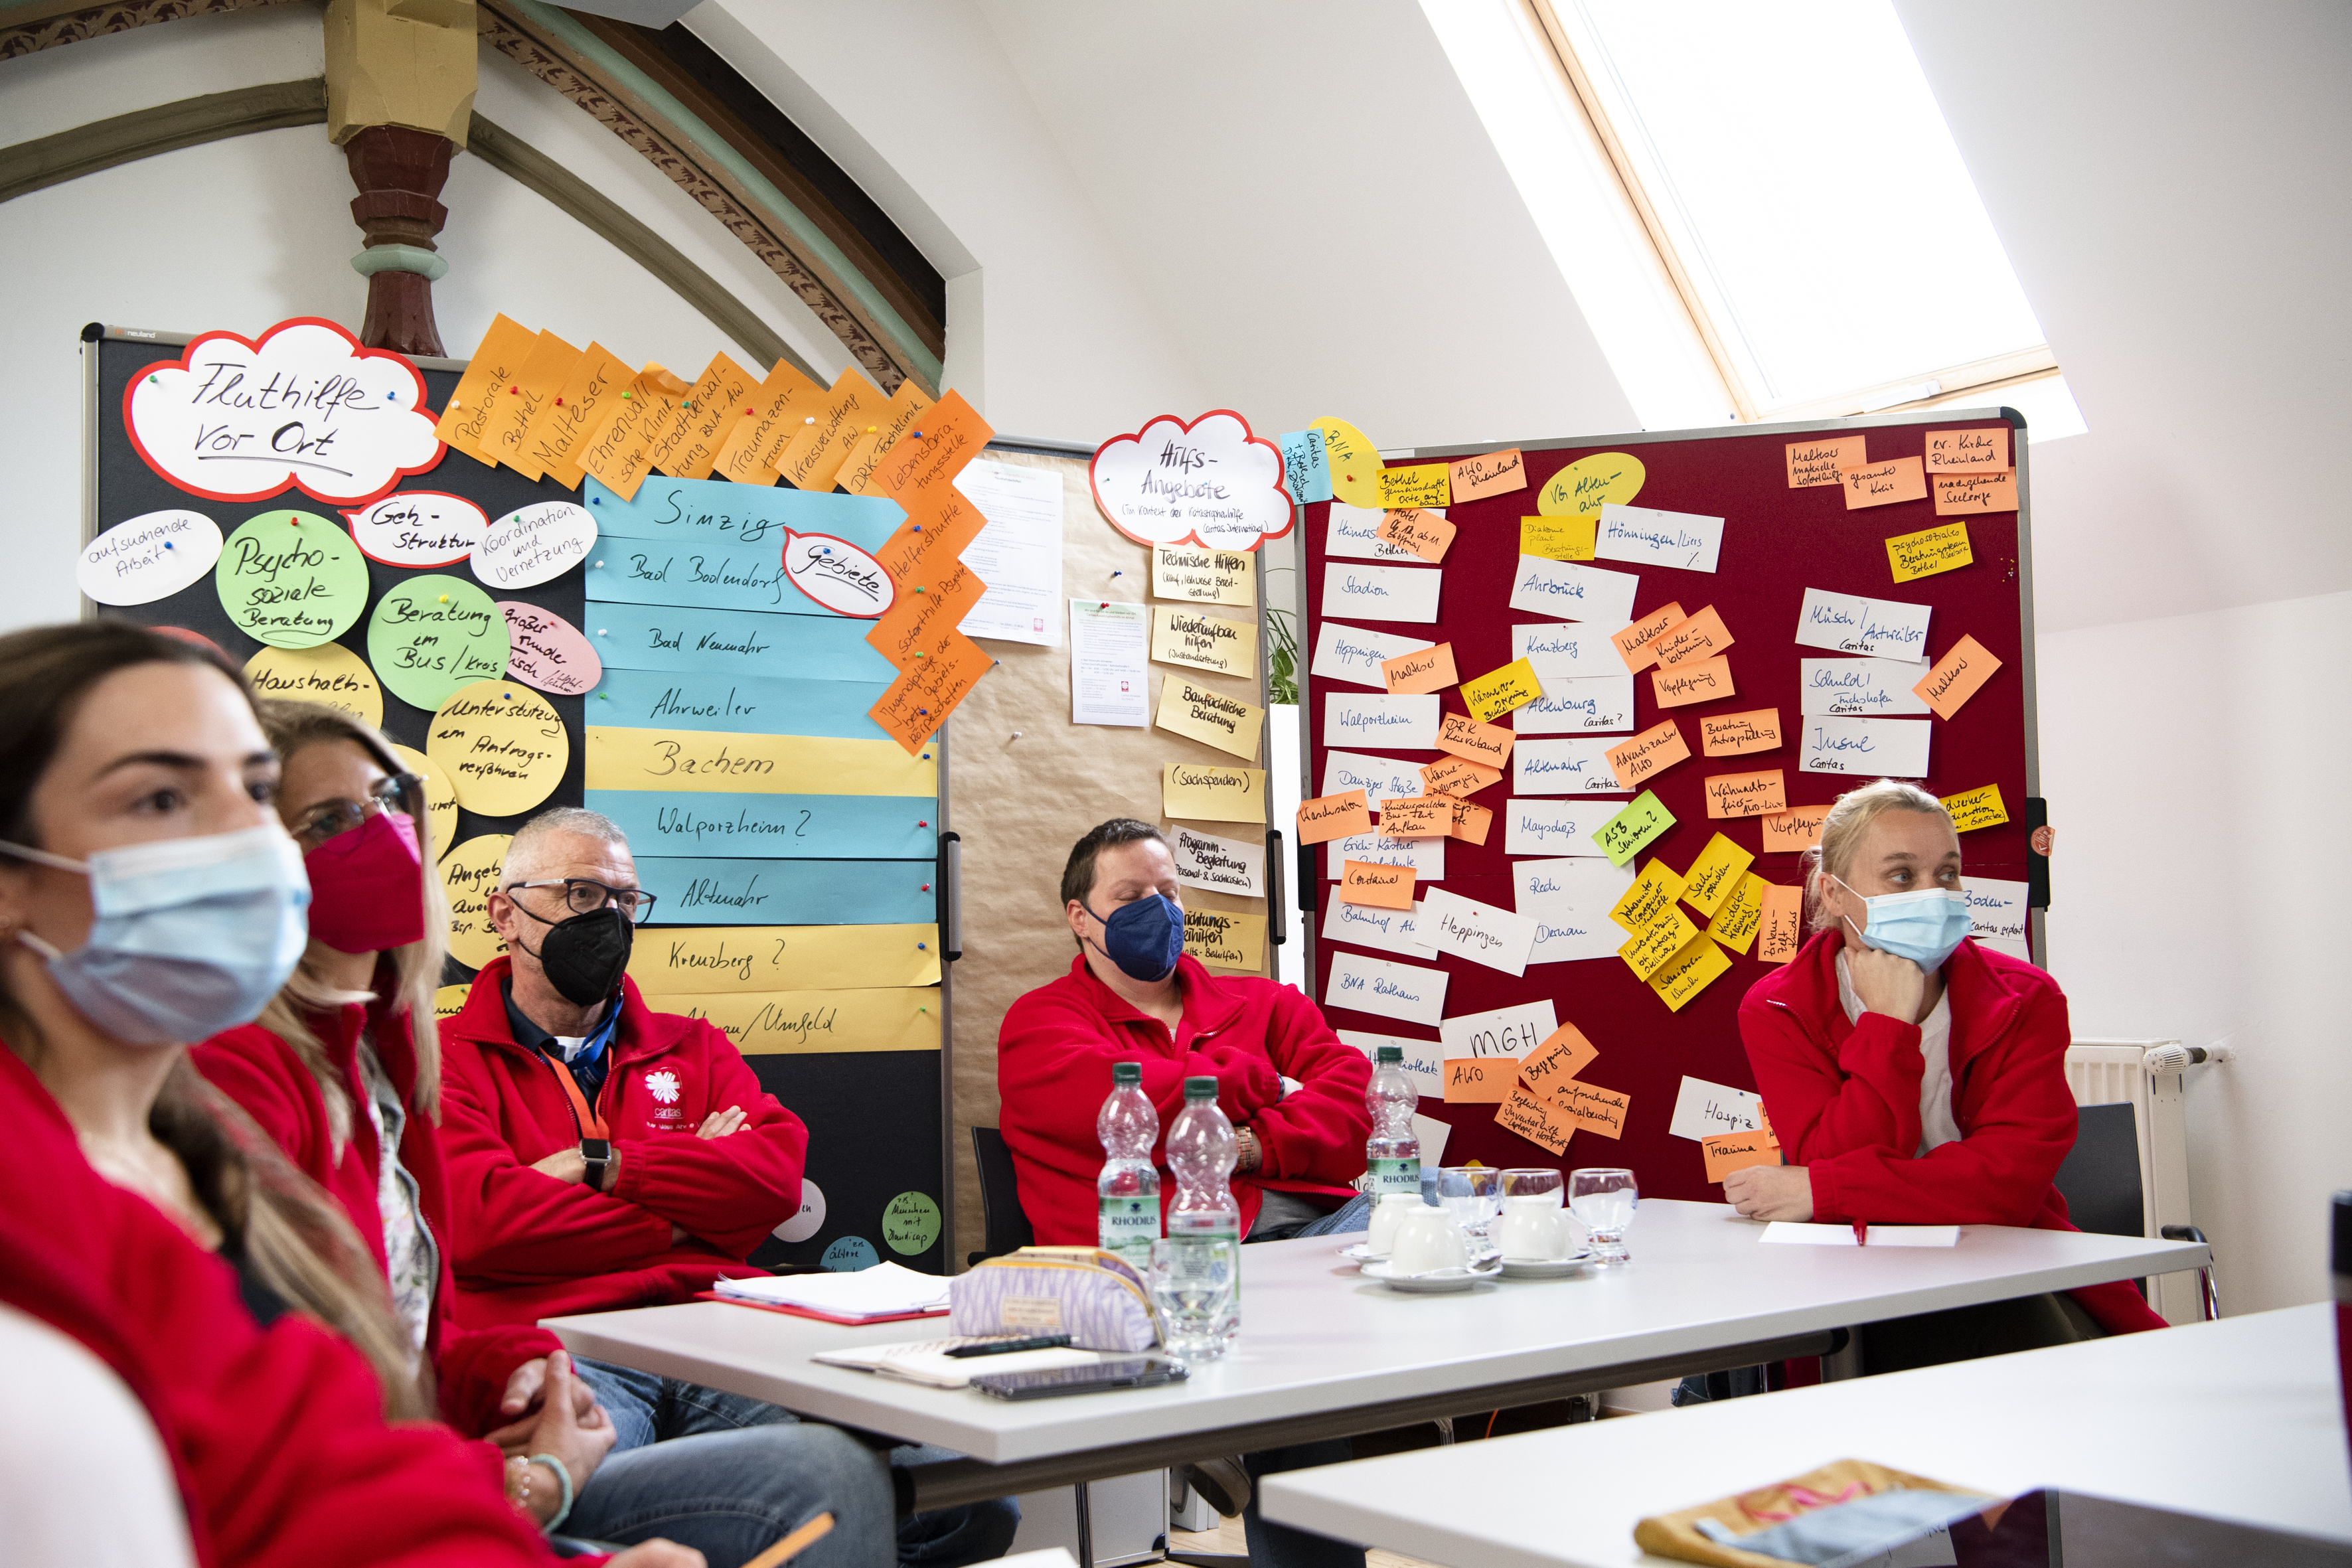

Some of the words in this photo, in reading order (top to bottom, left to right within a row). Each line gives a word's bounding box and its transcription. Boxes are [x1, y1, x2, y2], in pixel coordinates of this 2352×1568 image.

[127, 329, 156, 339] neuland
[192, 363, 380, 422] Fluthilfe
[454, 366, 512, 440] Pastorale
[502, 390, 544, 451] Bethel
[532, 362, 609, 469] Malteser
[639, 396, 674, 444] Klinik
[271, 421, 339, 455] Ort
[730, 388, 793, 474] Traumazen-
[789, 393, 860, 482] Kreisverwaltung
[842, 426, 859, 450] AW
[1932, 439, 1952, 451] ev.
[1958, 433, 1994, 451] Kirche
[671, 443, 710, 478] tung
[761, 433, 791, 469] trum
[886, 418, 959, 491] Lebensbera-
[1306, 433, 1322, 469] Caritas
[1324, 430, 1354, 463] BNA
[1792, 447, 1840, 464] Malteser
[1931, 451, 1997, 466] Rheinland
[913, 433, 969, 490] tungsstelle
[1457, 461, 1482, 480] AWO
[1470, 454, 1520, 488] Rheinland
[1140, 469, 1231, 505] Angebote
[1379, 471, 1420, 490] Bethel
[1869, 482, 1895, 496] Kreis
[1938, 473, 2007, 491] nachgehende
[1138, 505, 1167, 518] Kontext
[1170, 508, 1182, 518] der
[1943, 491, 1992, 507] Seelsorge
[653, 489, 786, 542] Sinzig
[1524, 523, 1565, 534] Diakonie
[89, 518, 192, 564] aufsuchende
[392, 532, 475, 550] Struktur
[479, 505, 576, 556] Koordination
[1528, 534, 1555, 547] plant
[1892, 528, 1960, 556] psychosoziales
[495, 536, 584, 582] Vernetzung
[512, 534, 542, 558] und
[1553, 552, 1575, 560] stelle
[116, 544, 167, 577] Arbeit
[791, 544, 880, 594] Gebiete
[1158, 548, 1211, 569] Technische
[1214, 552, 1245, 574] Hilfen
[1909, 560, 1938, 576] Bethel
[246, 576, 335, 605] soziale
[627, 554, 674, 583] Bad
[686, 555, 787, 605] Bodendorf
[1341, 575, 1390, 597] Stadion
[1520, 573, 1585, 599] Ahrbrück
[238, 607, 333, 643] Beratung
[381, 597, 492, 637] Beratung
[412, 631, 439, 647] im
[648, 627, 683, 653] Bad
[696, 630, 770, 656] Neuenahr
[1184, 633, 1213, 653] hilfen
[1620, 617, 1670, 656] Malteser
[1838, 638, 1875, 653] Caritas
[1860, 622, 1924, 643] Antweiler
[1334, 639, 1388, 668] Heppingen
[1526, 635, 1579, 659] Kreuzberg
[879, 655, 939, 728] Jugendpflege
[937, 634, 951, 654] der
[1389, 656, 1436, 687] Malteser
[1658, 672, 1717, 696] Verpflegung
[1926, 656, 1968, 702] Malteser
[649, 686, 756, 720] Ahrweiler
[907, 678, 967, 745] körperschaften
[1182, 686, 1247, 718] Baufachliche
[1526, 696, 1597, 715] Altenburg
[1828, 703, 1864, 714] Caritas
[1833, 689, 1893, 709] Fuchshofen
[1190, 705, 1236, 734] Beratung
[1446, 718, 1478, 735] DRK
[1583, 717, 1614, 728] Caritas
[1705, 718, 1753, 735] Beratung
[1443, 729, 1503, 755] Kreisverband
[1615, 728, 1678, 769] Adventszauber
[459, 762, 528, 780] verfahren
[643, 740, 775, 776] Bachem
[1524, 756, 1589, 776] Altenahr
[1630, 758, 1653, 777] AWO
[1808, 757, 1845, 771] Caritas
[1337, 769, 1384, 797] Danziger
[1387, 775, 1419, 799] Straße
[1585, 777, 1620, 791] Caritas
[657, 807, 786, 842] Walporzheim
[1298, 799, 1364, 823] Waschsalon
[1385, 819, 1427, 834] Aufbau
[1521, 815, 1576, 840] Mayschoß
[1604, 820, 1628, 848] ASB
[1617, 823, 1652, 854] Senioren
[1195, 850, 1247, 874] Begleitung
[1203, 871, 1210, 881] &
[680, 874, 769, 908] Altenahr
[1349, 868, 1399, 886] Container
[1529, 877, 1561, 894] Rech
[1703, 862, 1731, 902] spenden
[1617, 878, 1652, 926] Johanniter
[1340, 904, 1391, 933] Bahnhof
[1440, 913, 1504, 949] Heppingen
[1534, 924, 1587, 944] Dernau
[668, 940, 754, 981] Kreuzberg
[1660, 953, 1703, 990] Senioren
[1340, 973, 1366, 992] BNA
[1373, 977, 1421, 1002] Rathaus
[1469, 1022, 1538, 1058] MGH
[1452, 1066, 1484, 1085] AWO
[1509, 1089, 1548, 1121] Begleitung
[1557, 1085, 1625, 1109] aufsuchende
[1704, 1099, 1755, 1131] Hospiz
[1705, 1140, 1757, 1158] Trauma
[903, 1217, 921, 1227] mit
[1111, 1215, 1157, 1227] RHODIUS
[829, 1247, 860, 1260] ältere
